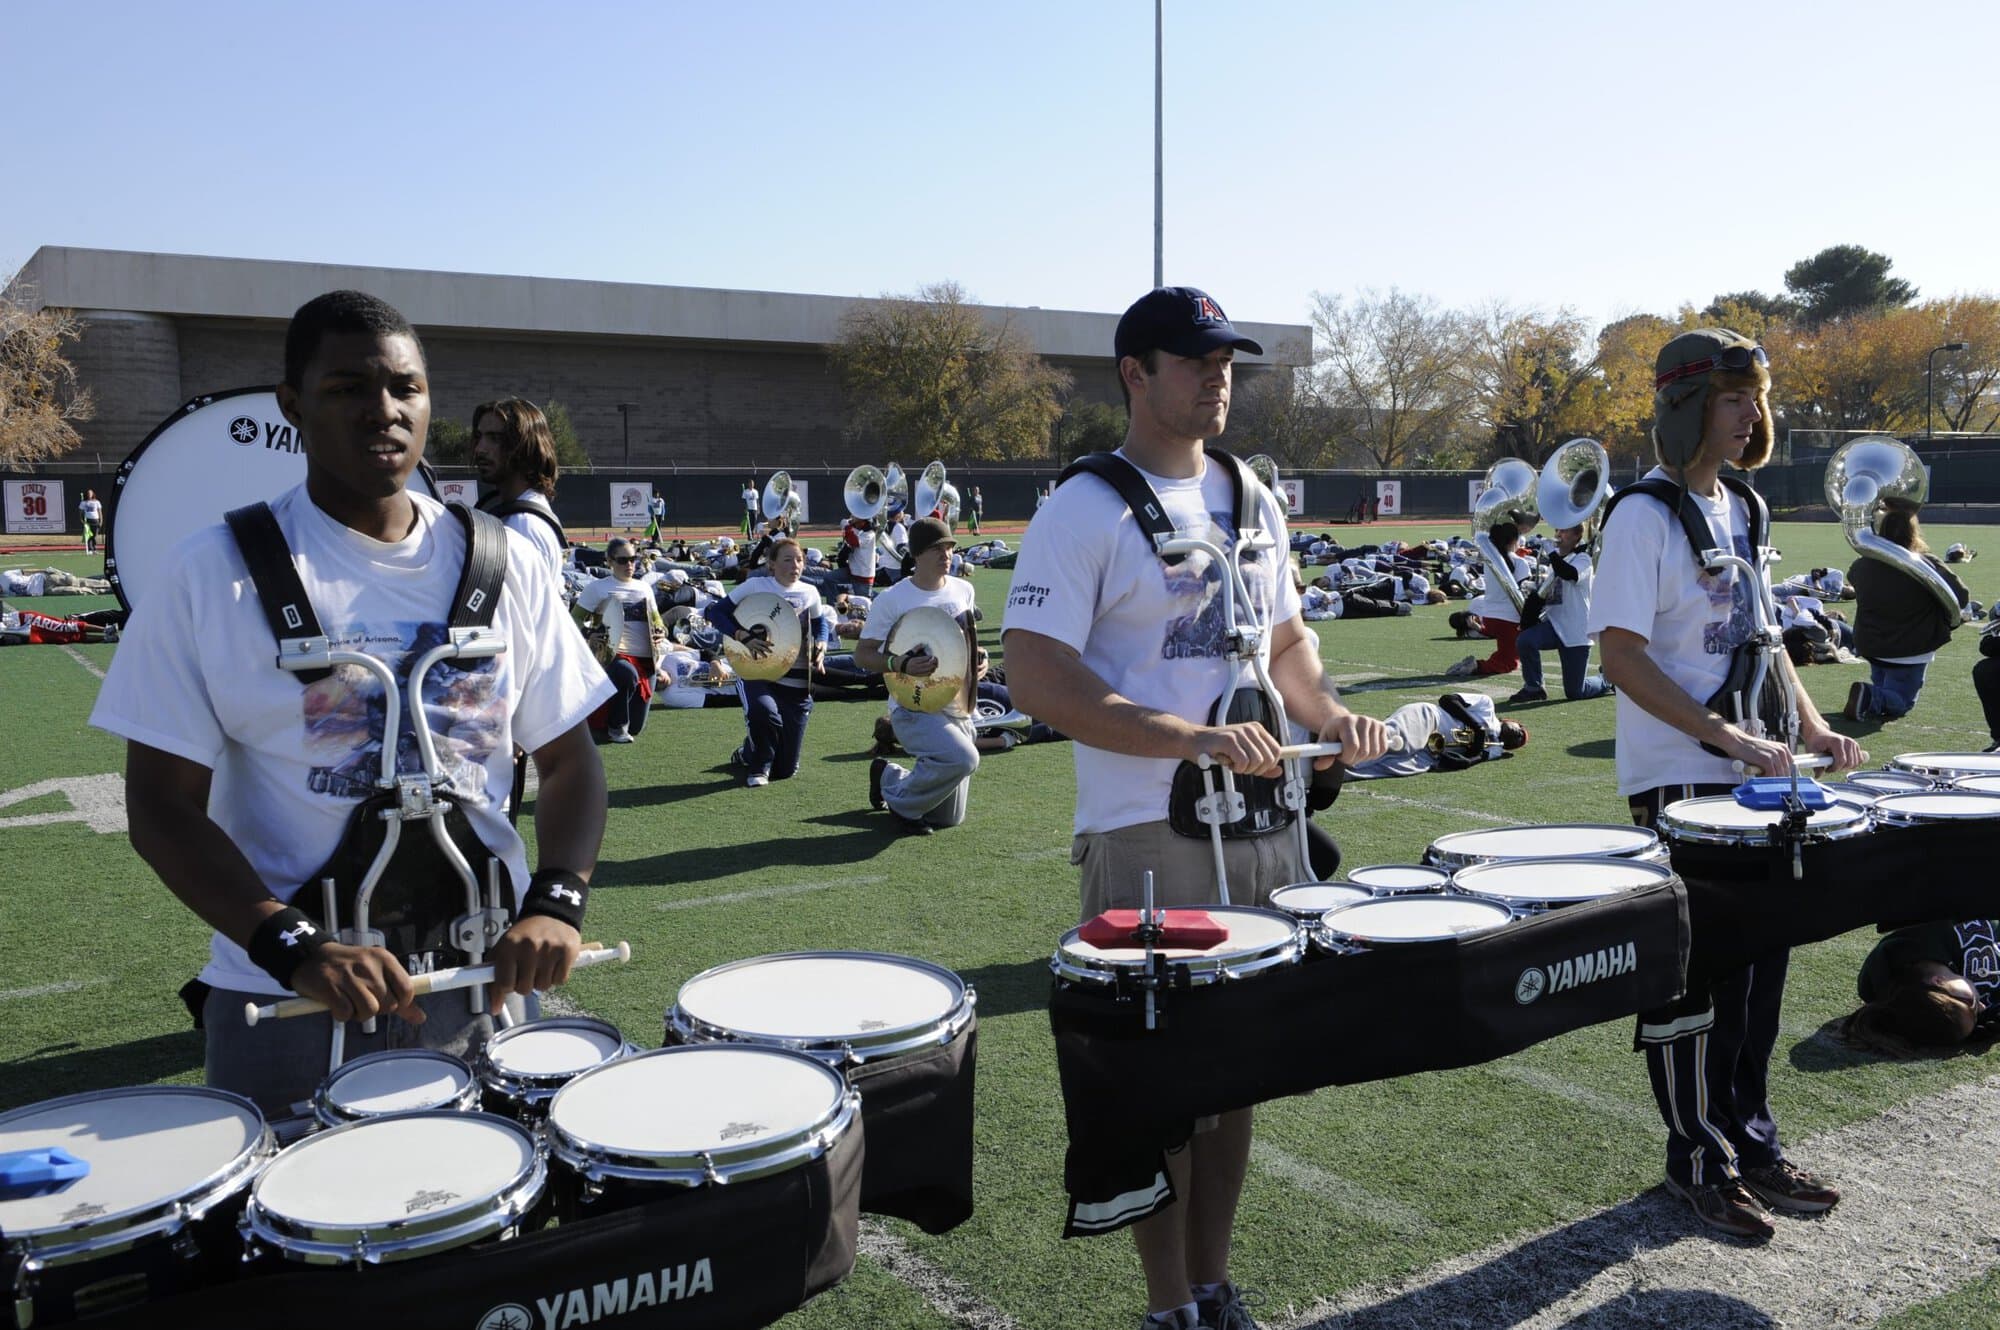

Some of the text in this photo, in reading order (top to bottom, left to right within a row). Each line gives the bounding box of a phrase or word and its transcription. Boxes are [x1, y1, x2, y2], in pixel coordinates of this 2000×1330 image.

[1192, 296, 1228, 325] A
[265, 422, 306, 454] YAM
[23, 496, 46, 516] 30
[1547, 941, 1637, 994] YAMAHA
[536, 1257, 714, 1330] YAMAHA
